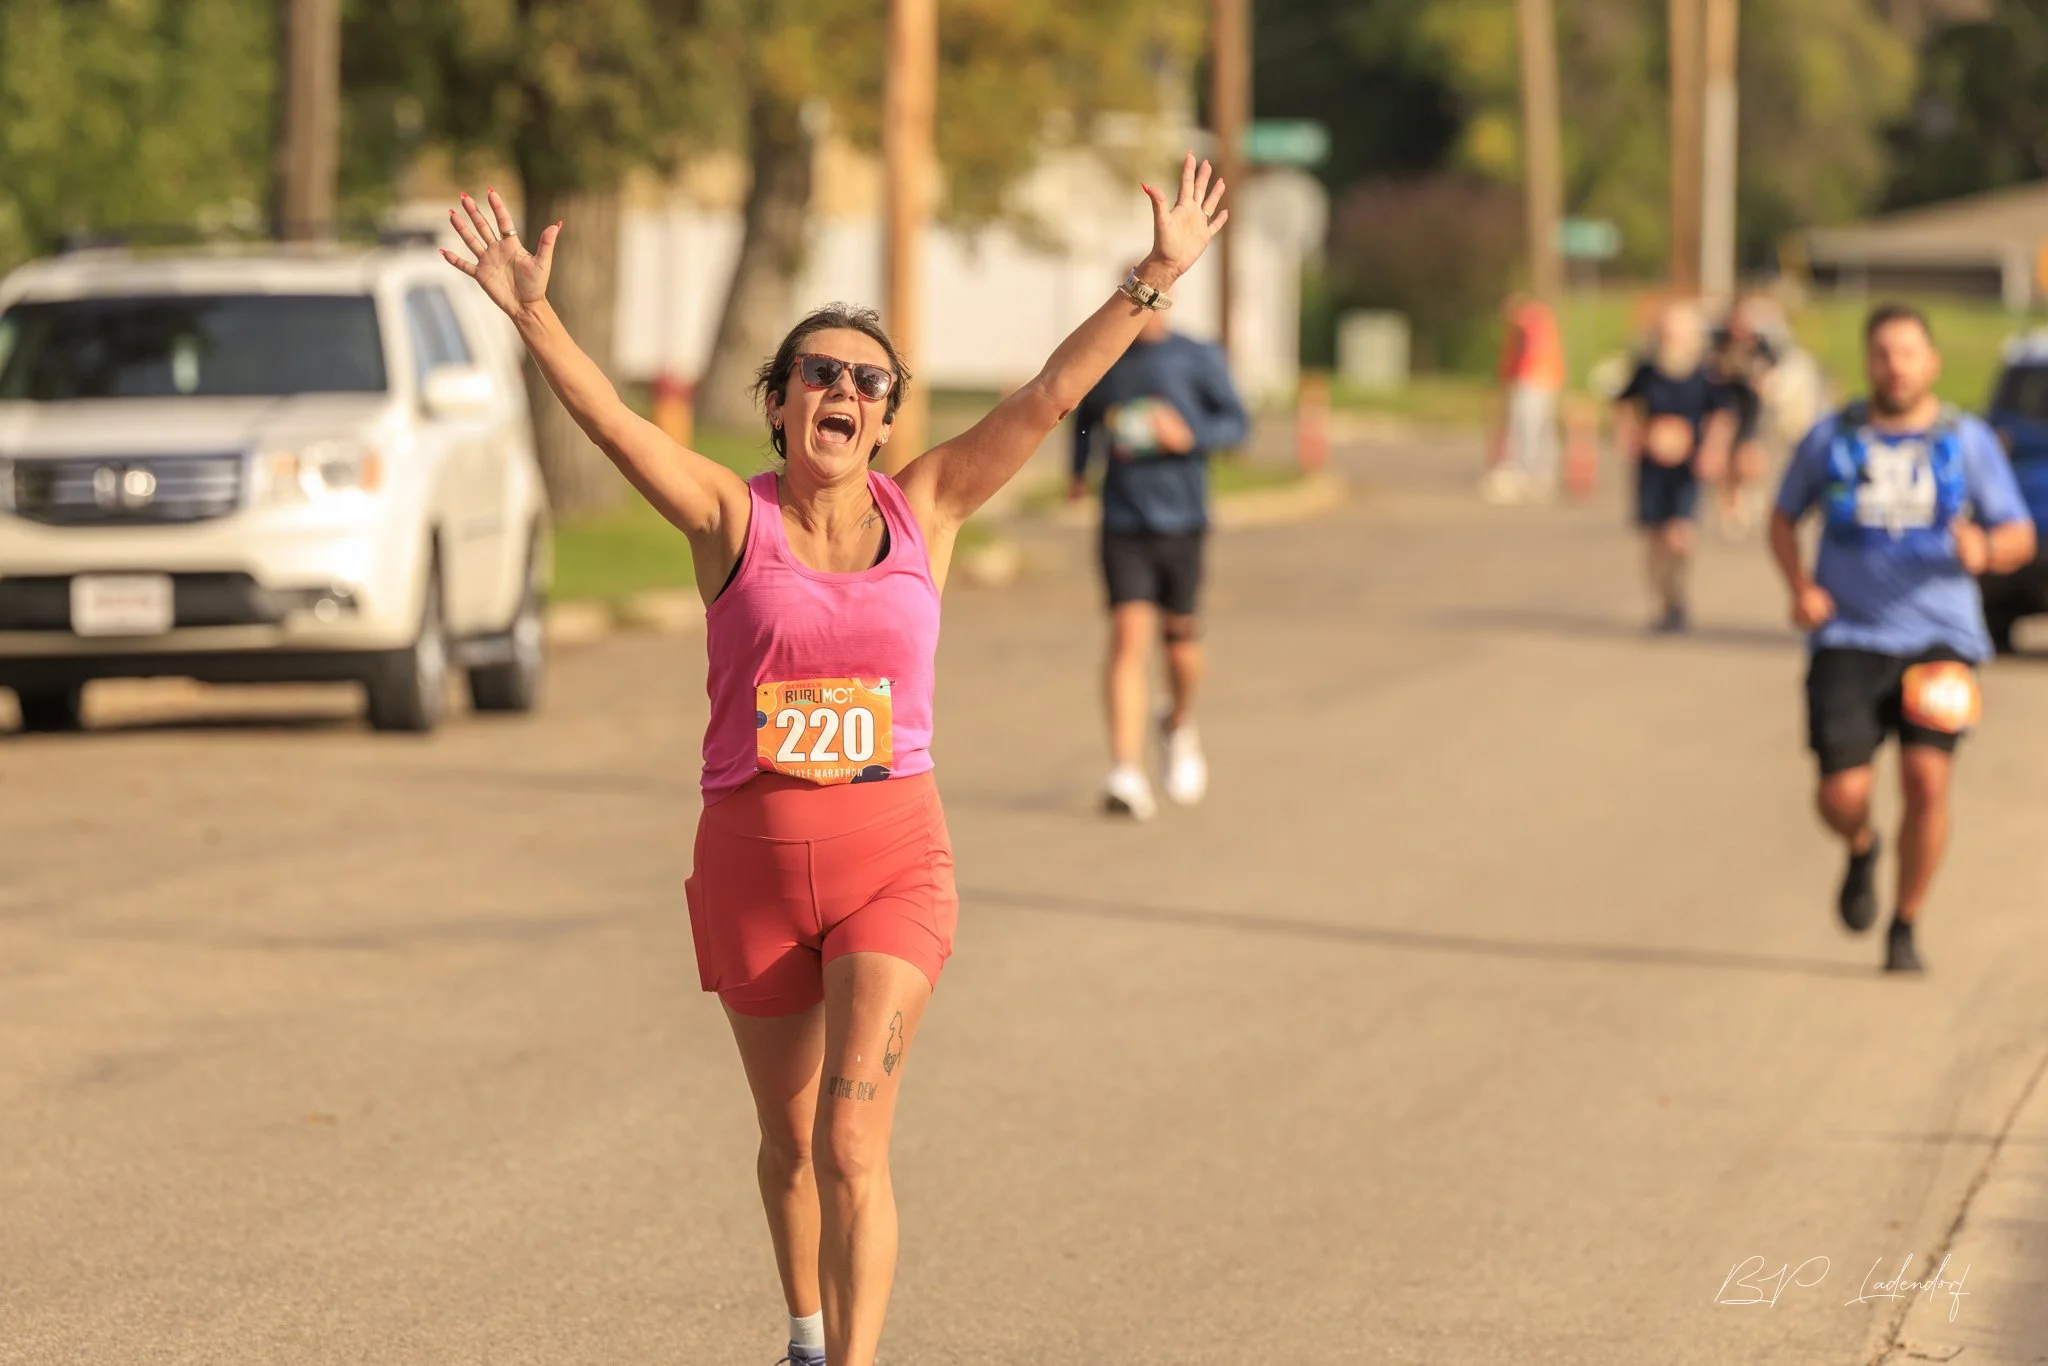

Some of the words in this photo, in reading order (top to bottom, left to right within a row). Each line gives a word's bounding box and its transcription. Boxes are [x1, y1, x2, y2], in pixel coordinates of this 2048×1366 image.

[775, 707, 875, 762] 220
[789, 768, 811, 778] HALF
[814, 767, 863, 778] MARATHON
